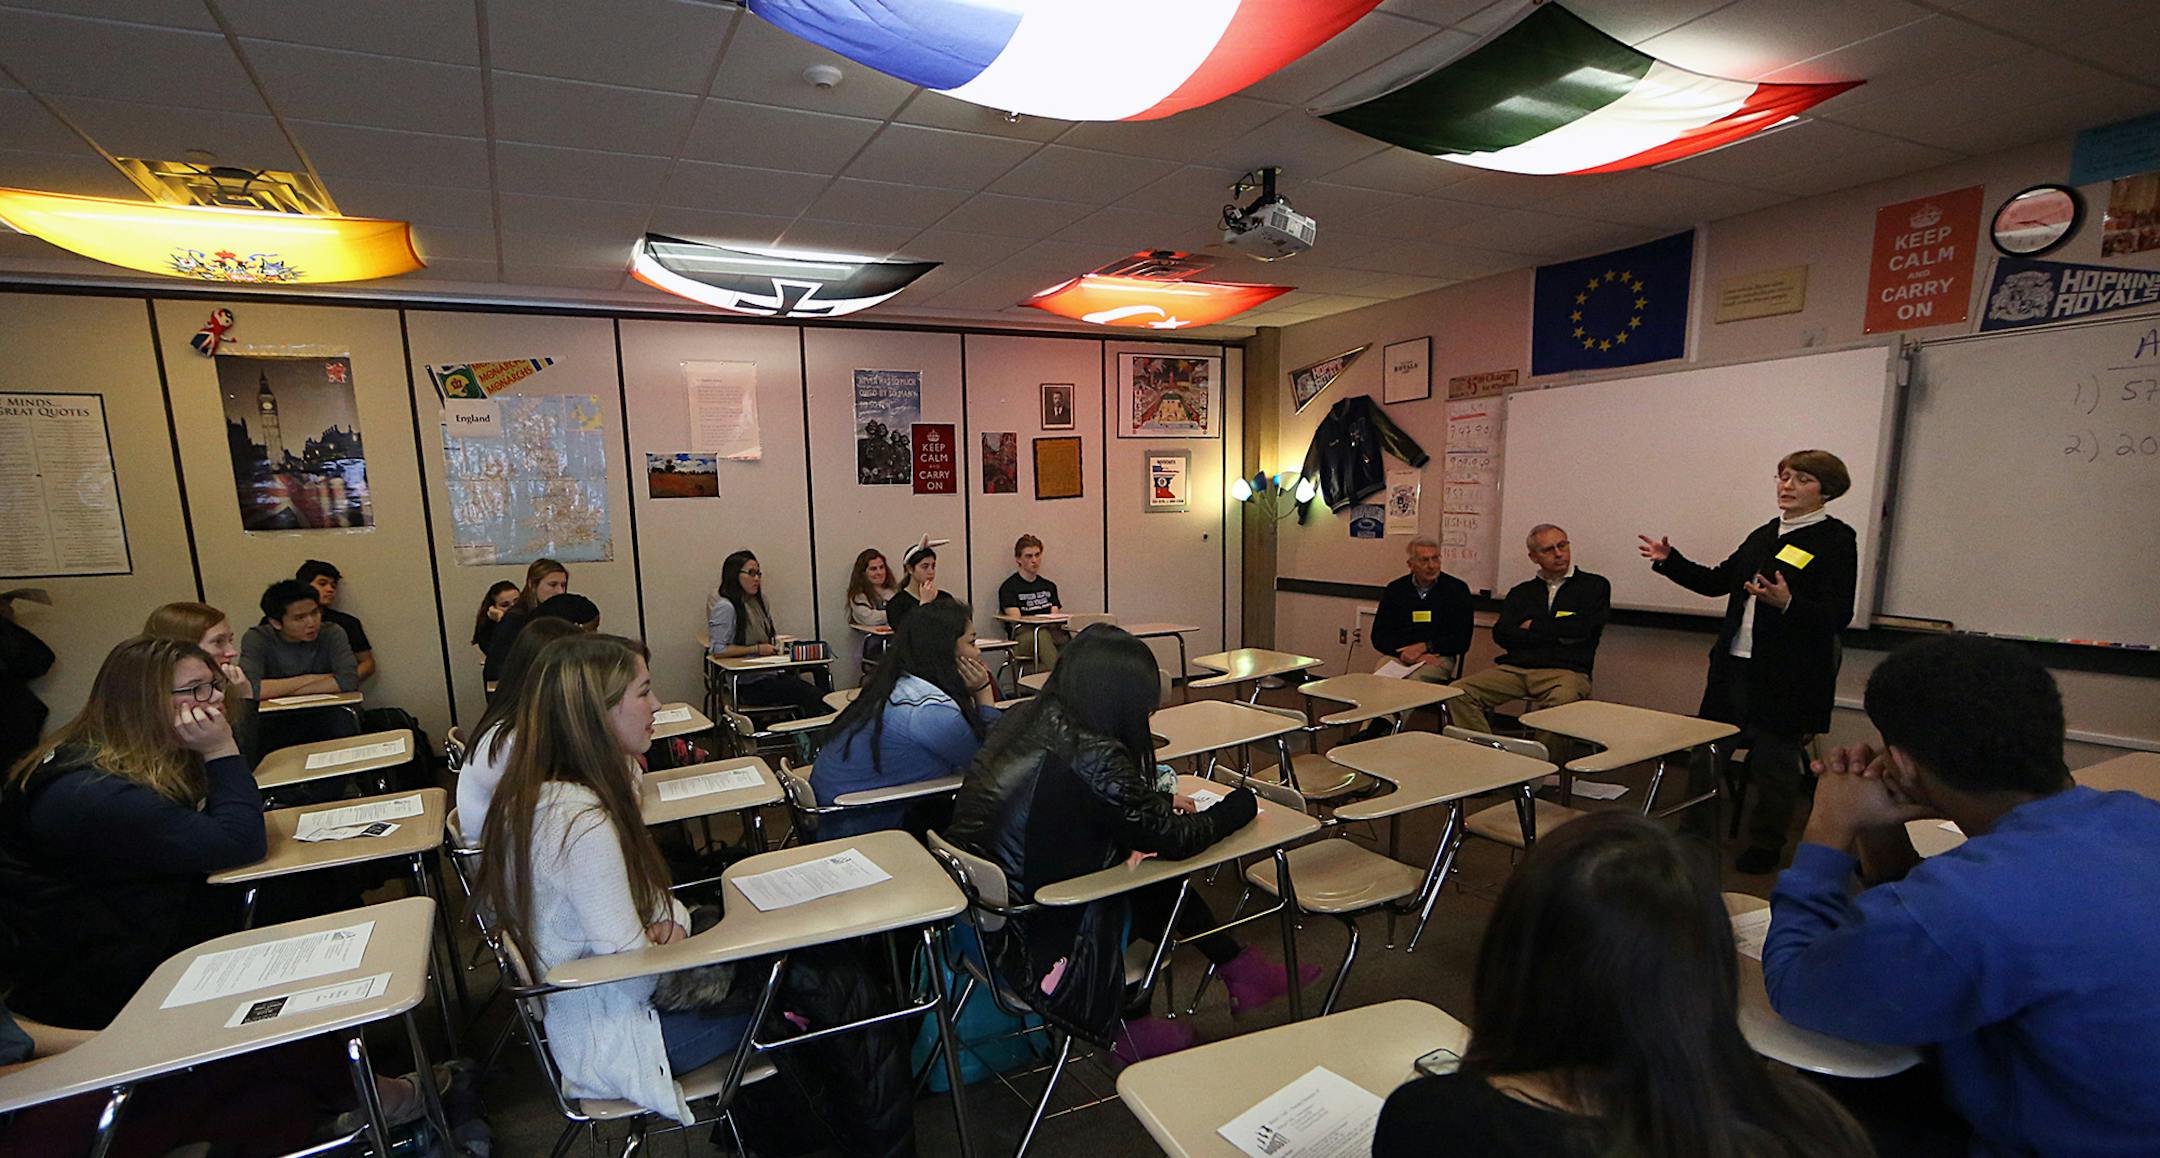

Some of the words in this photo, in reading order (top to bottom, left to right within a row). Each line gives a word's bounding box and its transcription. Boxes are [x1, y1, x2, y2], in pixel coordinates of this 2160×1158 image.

[1895, 226, 1952, 251] KEEP
[1888, 246, 1955, 271] CALM
[1907, 269, 1930, 280] AND
[1881, 277, 1955, 303] CARRY
[2052, 287, 2159, 318] ROYALS
[1897, 301, 1933, 320] ON
[479, 359, 526, 382] MONARCH
[38, 407, 90, 418] QUOTES
[456, 414, 490, 424] England
[922, 443, 946, 452] KEEP
[920, 454, 948, 463] CALM
[919, 471, 950, 480] CARRY
[927, 481, 943, 490] ON
